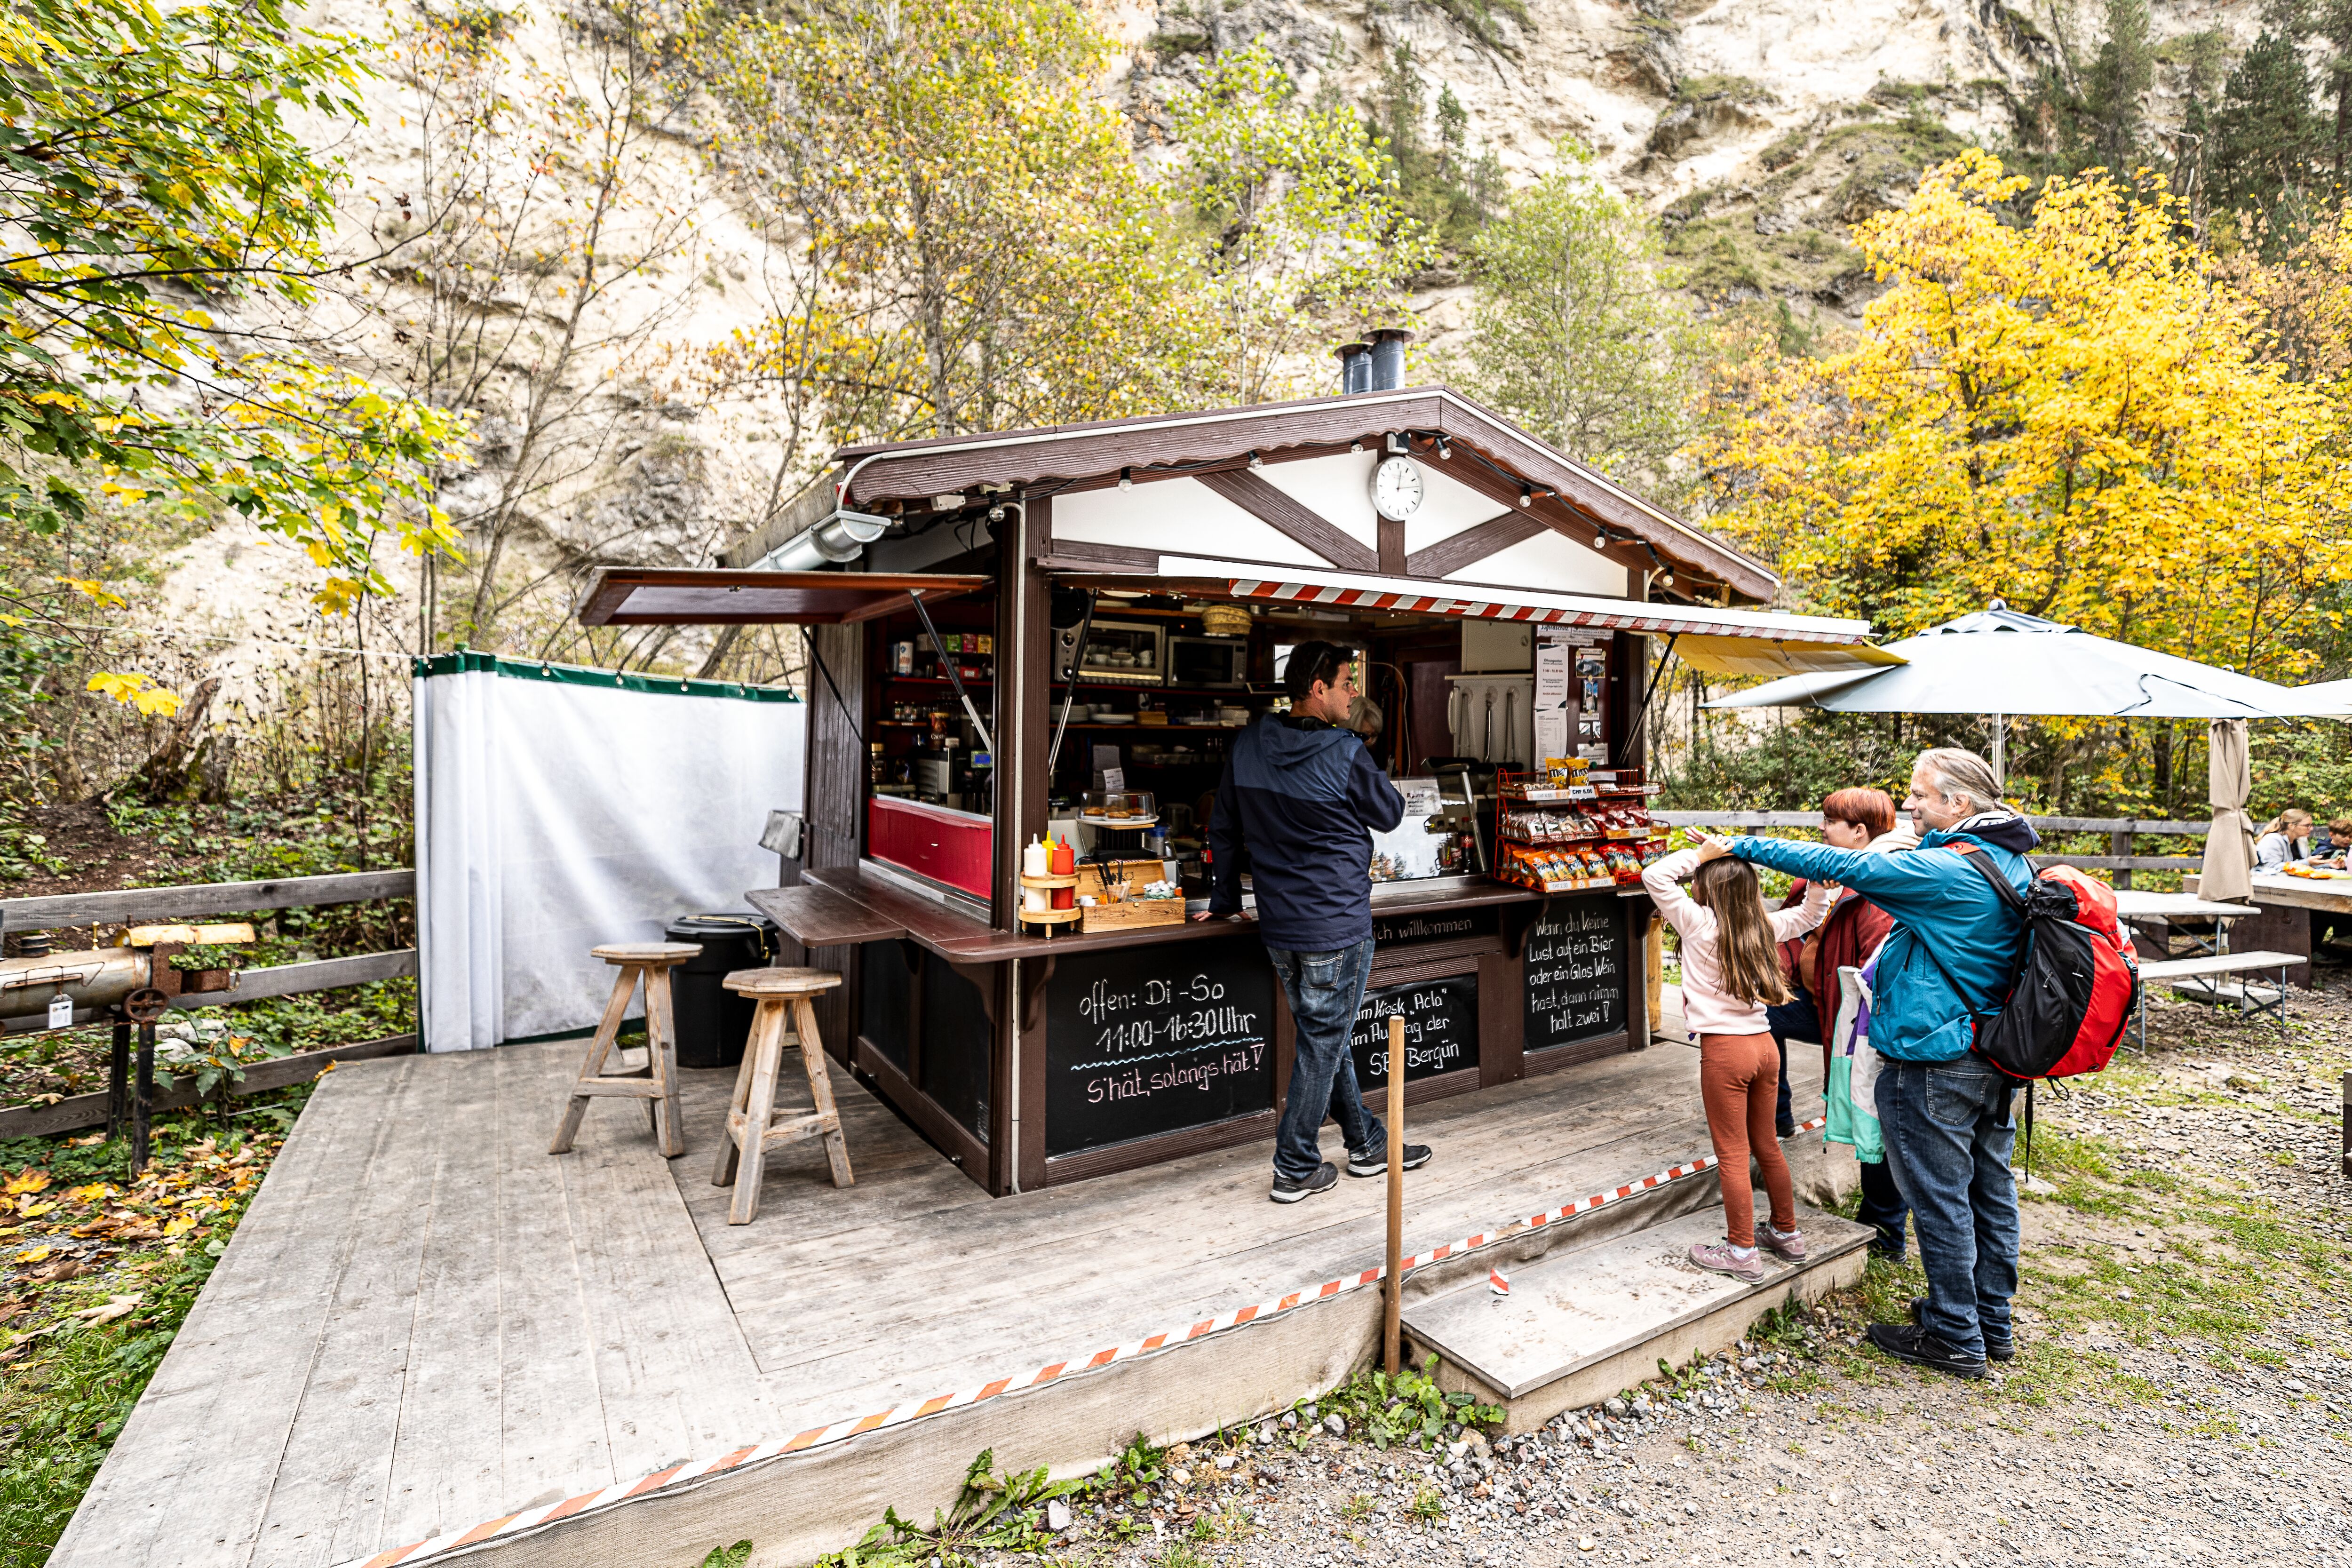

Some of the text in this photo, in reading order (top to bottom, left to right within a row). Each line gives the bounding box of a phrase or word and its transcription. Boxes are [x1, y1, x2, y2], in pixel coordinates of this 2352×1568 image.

[1373, 919, 1472, 940] ich willkommen
[1536, 917, 1562, 936] Wenn
[1565, 913, 1580, 933] du
[1529, 935, 1614, 964] Lust auf ein Bier
[1530, 956, 1615, 985] oder ein Glas Wein
[1080, 979, 1136, 1024] offen:
[1145, 979, 1172, 1005] Di
[1375, 997, 1406, 1019] Kiosk
[1531, 984, 1619, 1012] hast, dann nimm
[1351, 1032, 1368, 1046] im
[1427, 1015, 1450, 1030] der
[1550, 1008, 1573, 1033] halt
[1405, 1039, 1459, 1069] Bergün
